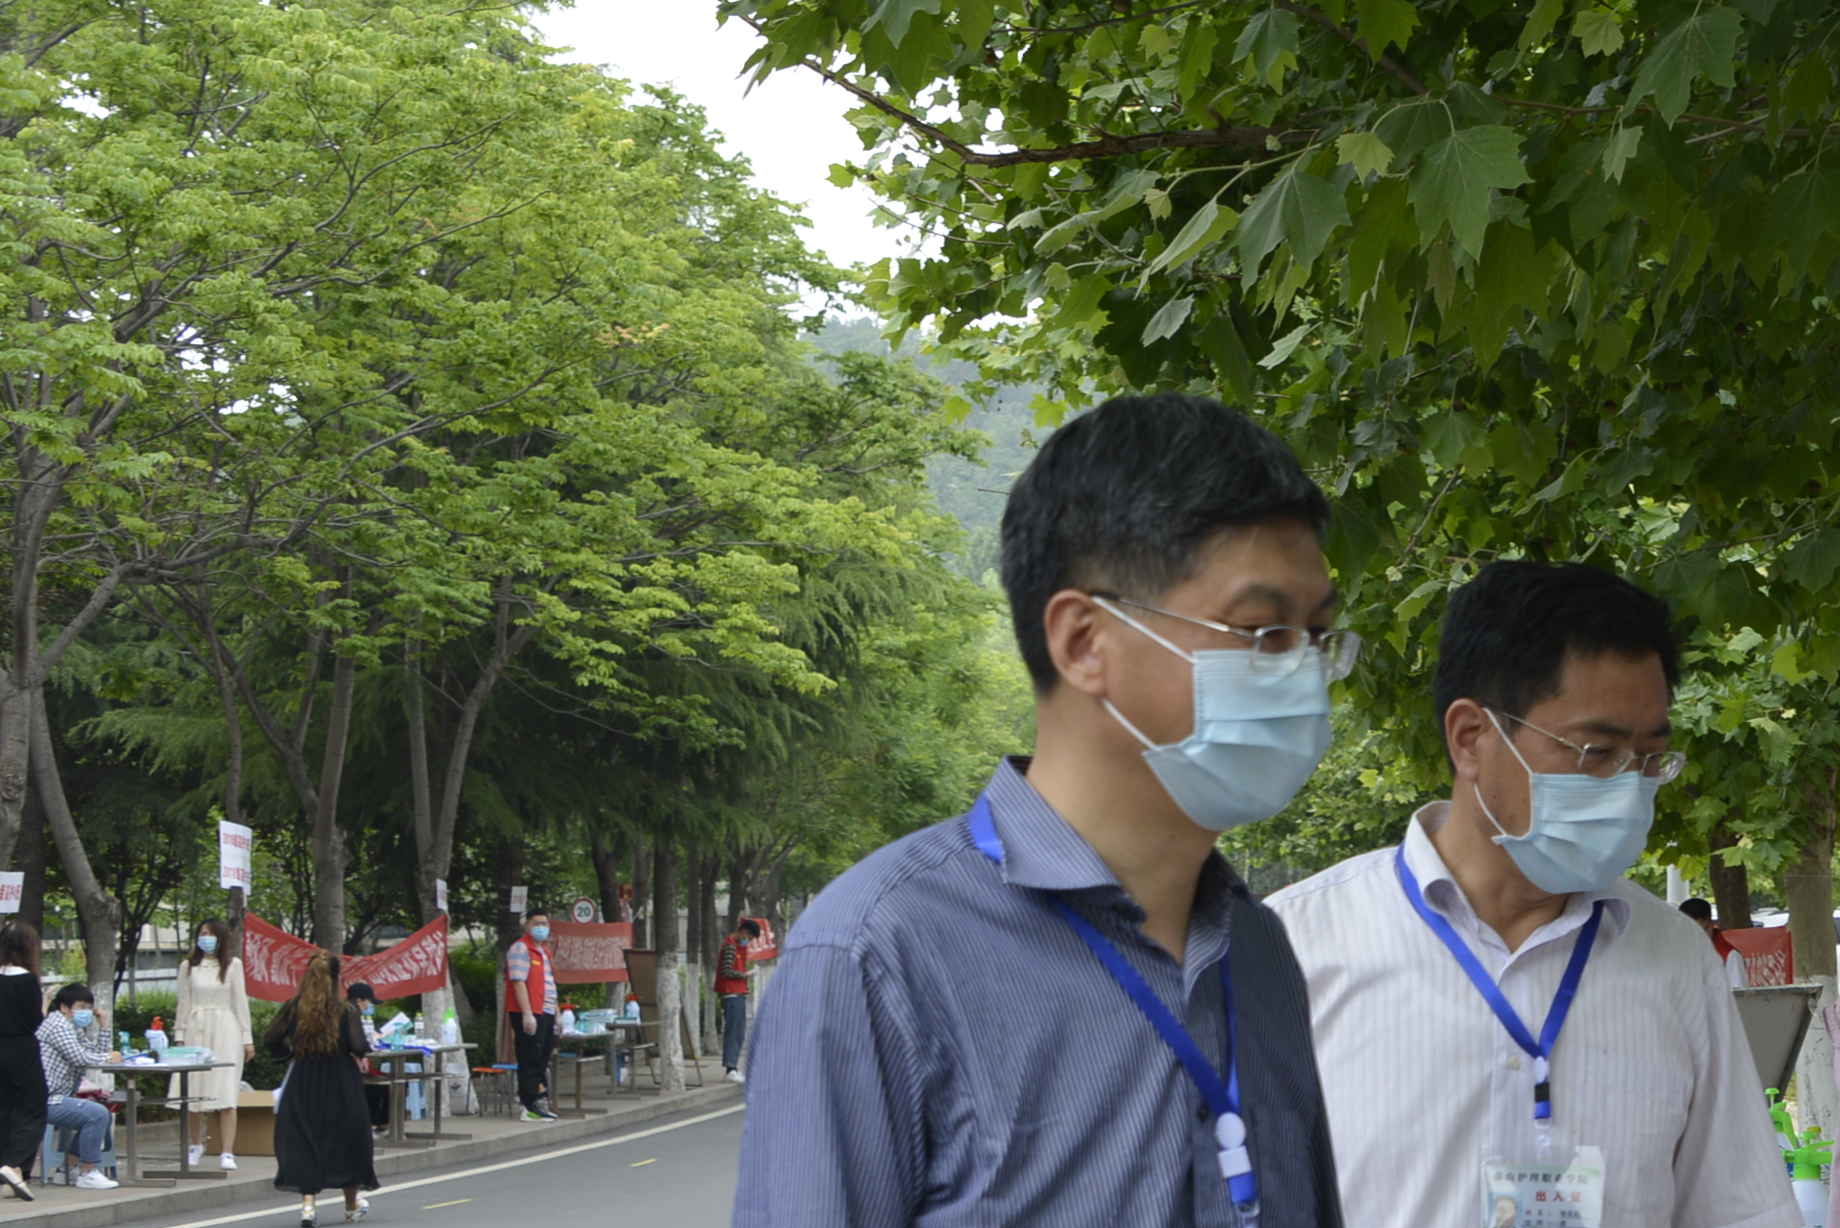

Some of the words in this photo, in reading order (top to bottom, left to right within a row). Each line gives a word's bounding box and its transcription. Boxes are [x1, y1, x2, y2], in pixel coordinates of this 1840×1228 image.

[576, 906, 591, 918] 20
[1493, 1171, 1589, 1185] 泰山护理职业学院
[1535, 1189, 1583, 1203] 出入证
